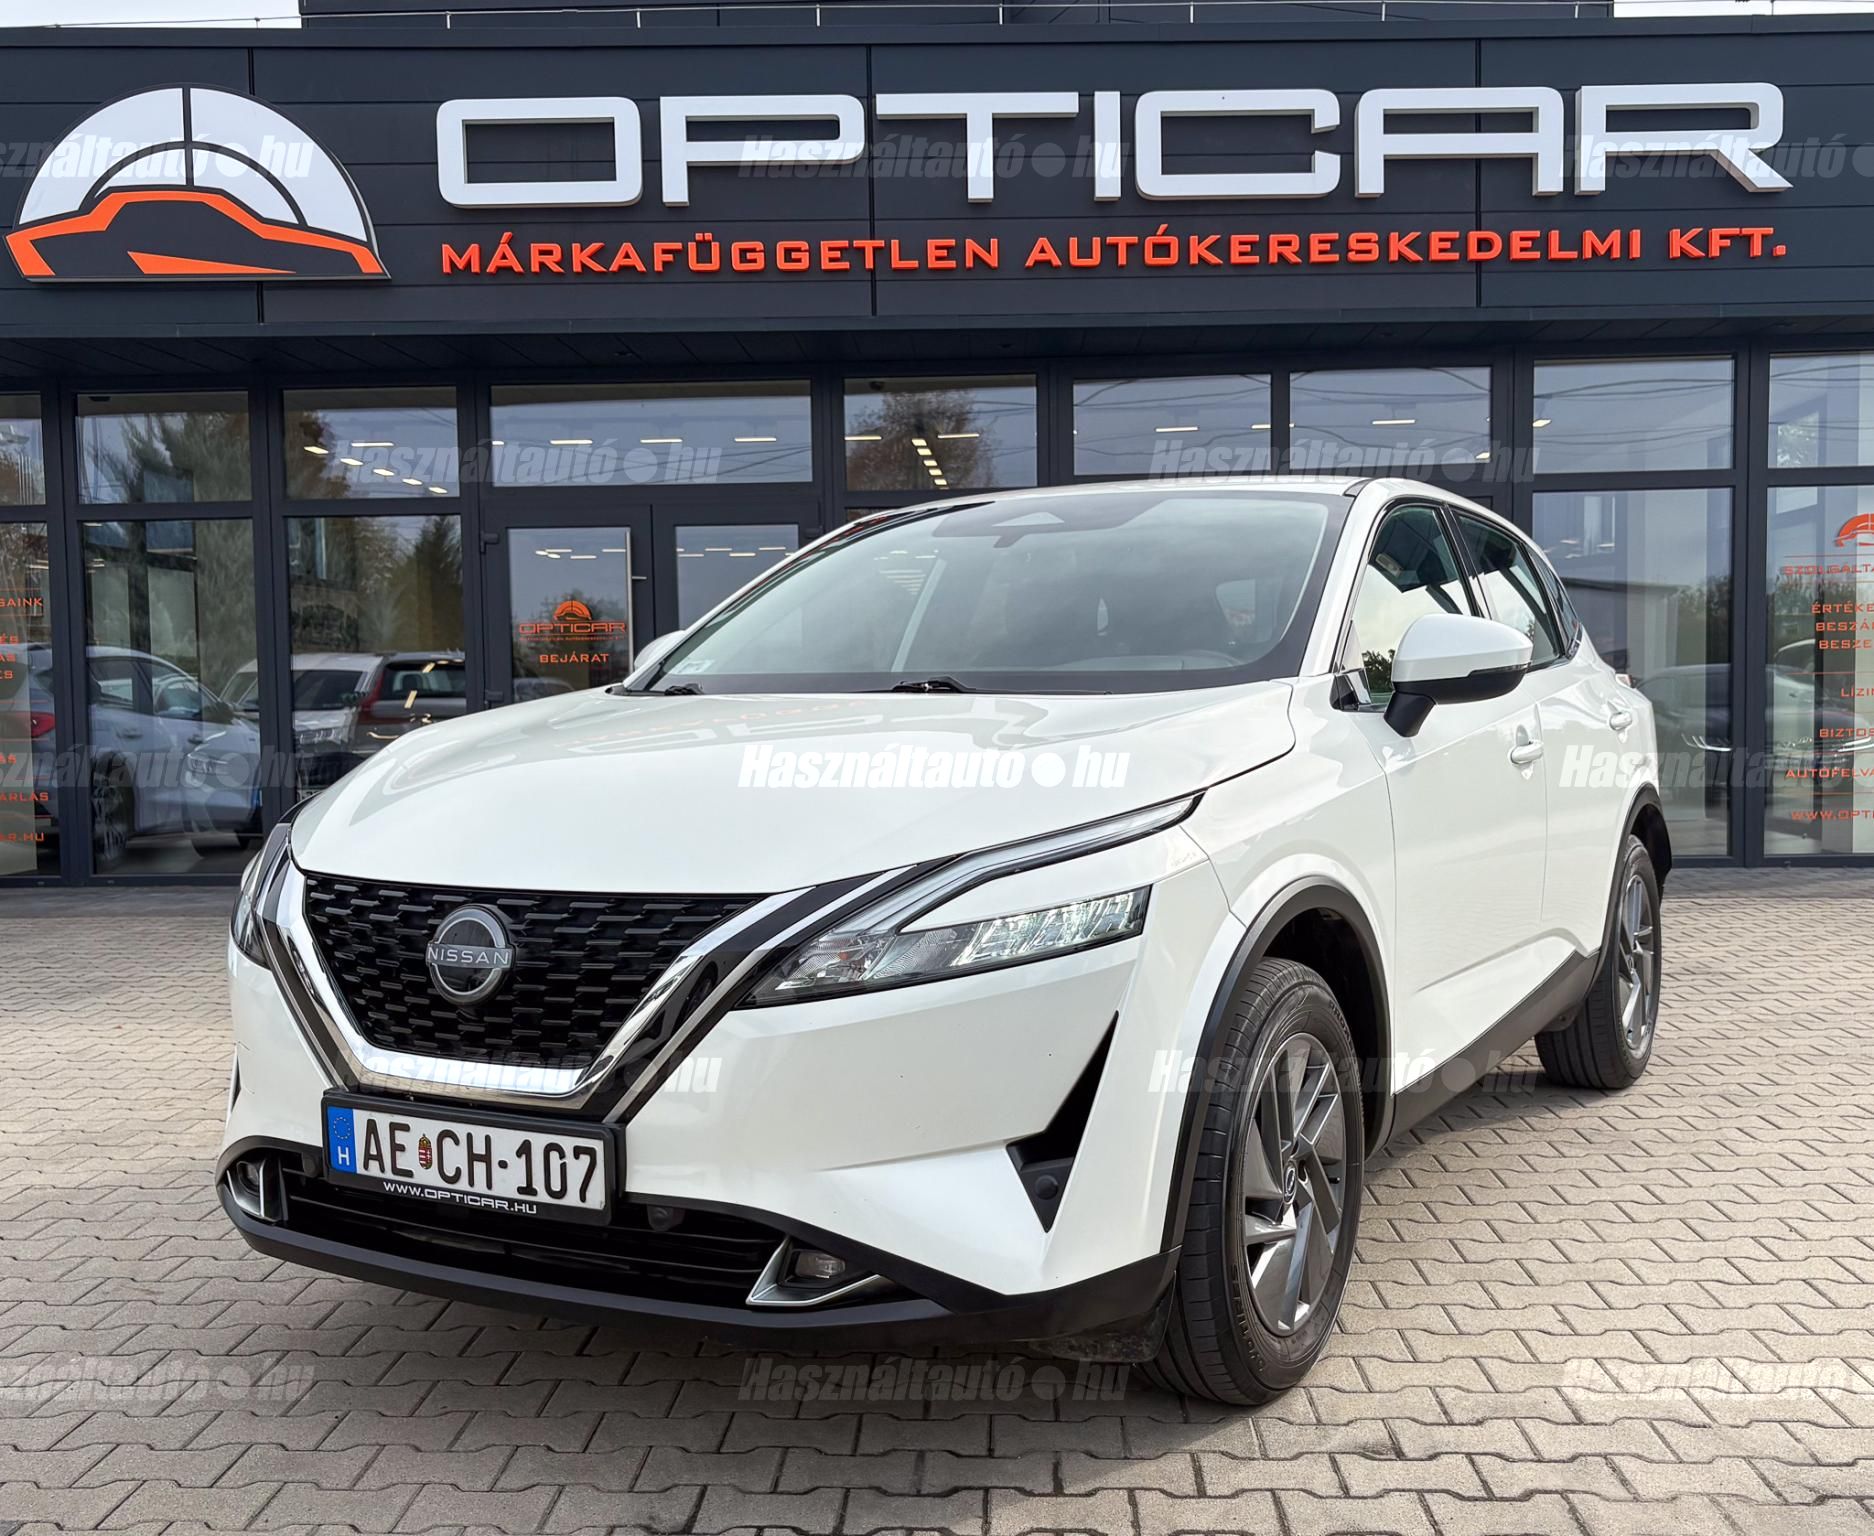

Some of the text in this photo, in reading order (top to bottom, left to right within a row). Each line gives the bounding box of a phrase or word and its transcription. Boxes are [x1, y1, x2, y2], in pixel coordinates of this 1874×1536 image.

[436, 82, 1793, 209] OPTICAR
[440, 223, 1787, 274] MÁRKAFÜGGETLEN AUTÓKERESKEDELMI KFT.
[1783, 563, 1874, 577] SZOLGÁLT
[519, 622, 626, 634] OPTICAR
[1815, 618, 1874, 632] BESZÁ
[1819, 639, 1872, 650] BESZE
[539, 650, 609, 663] BEJÁRAT
[427, 946, 509, 965] NISSAN
[337, 1146, 351, 1167] H
[382, 1181, 537, 1215] WWW.OPTICAR.HU
